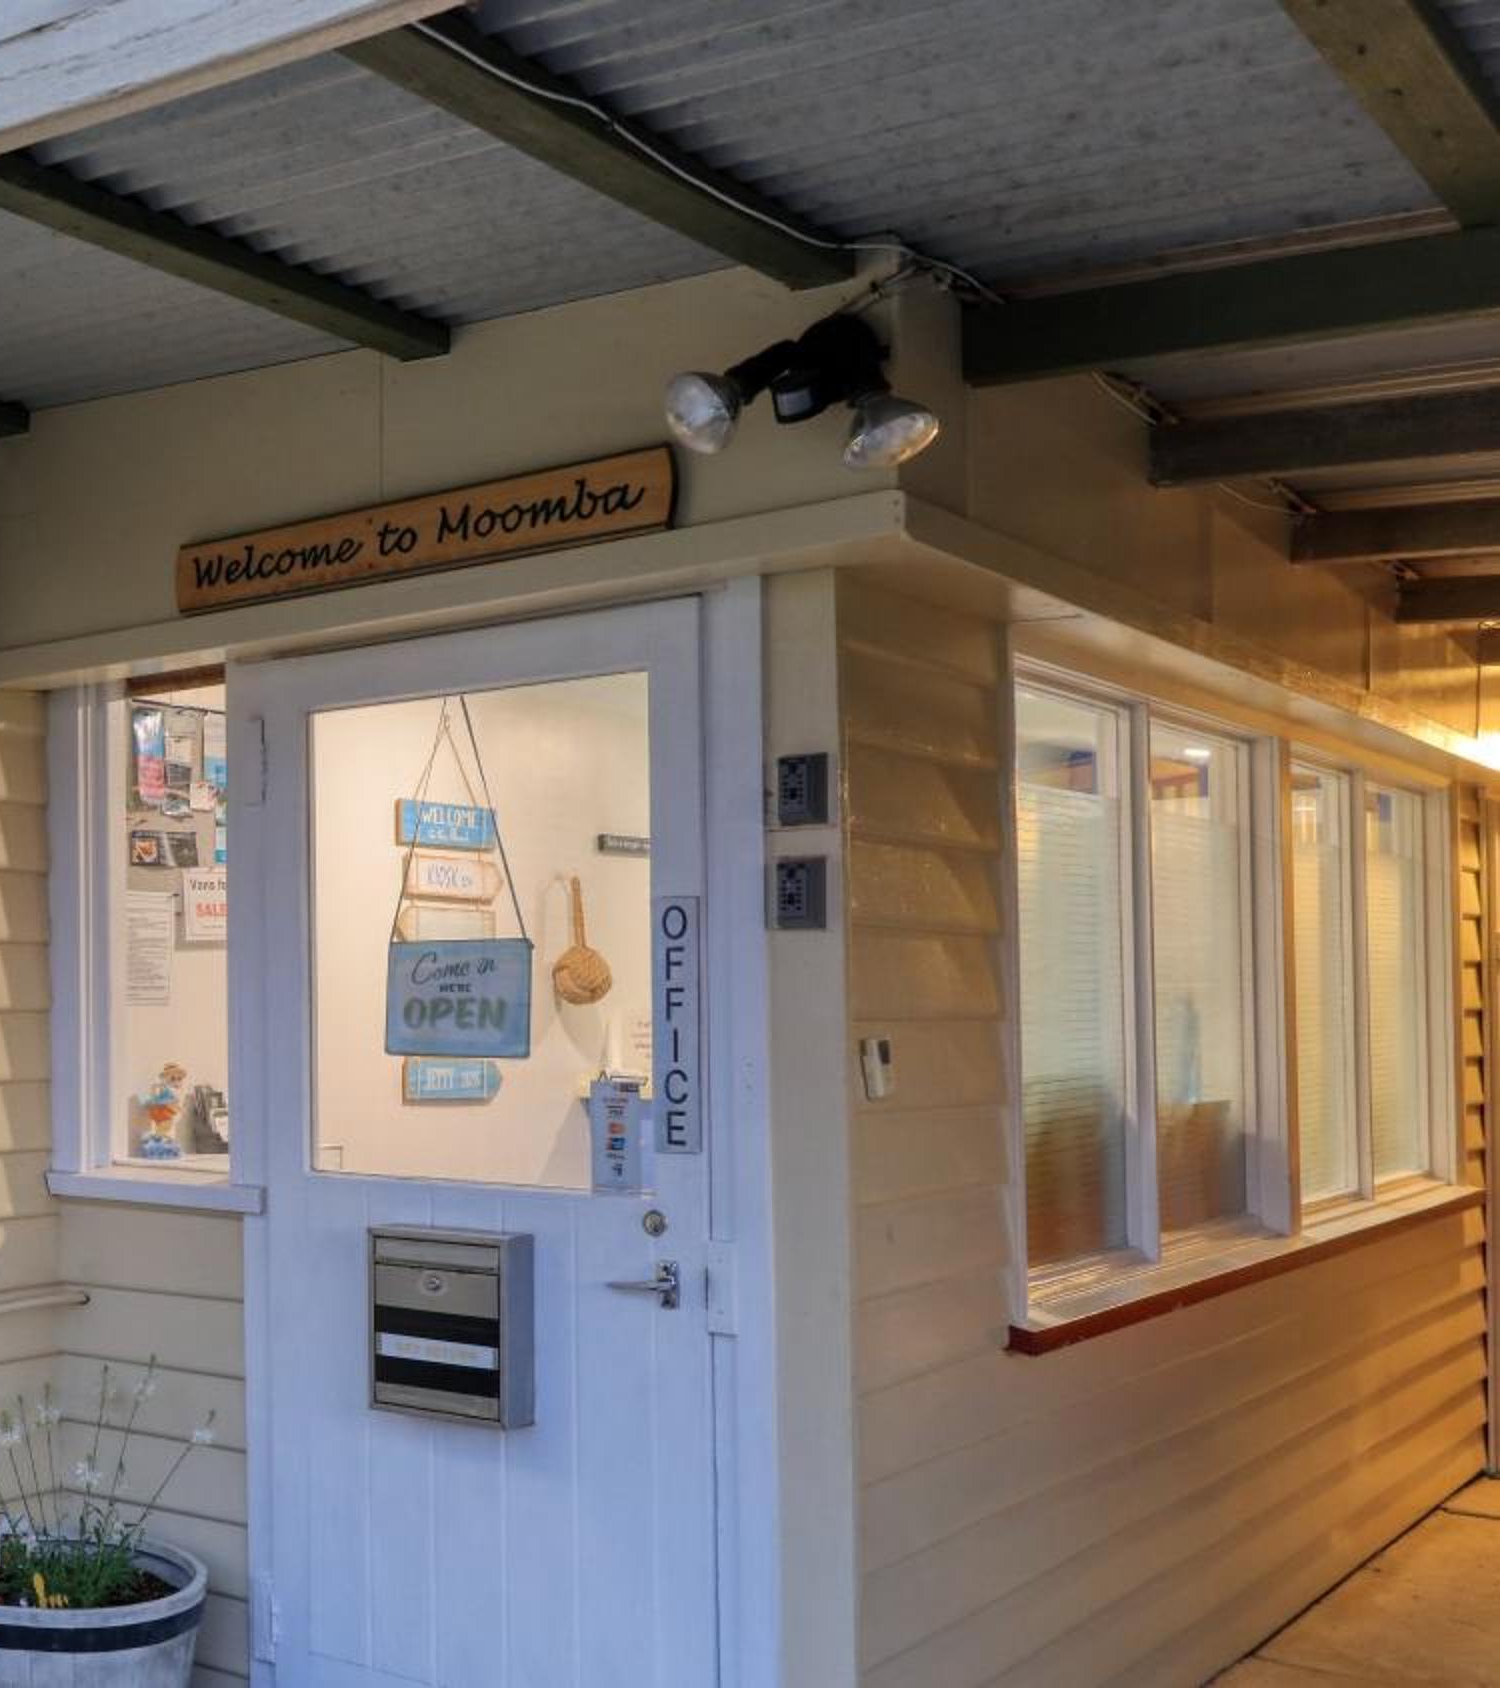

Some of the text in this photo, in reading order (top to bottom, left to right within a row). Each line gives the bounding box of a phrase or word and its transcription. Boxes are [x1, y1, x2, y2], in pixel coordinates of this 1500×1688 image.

[192, 478, 645, 590] Welcome to Moomba
[420, 806, 476, 829] WELCOME
[217, 878, 228, 892] fo
[195, 902, 228, 919] SALE
[411, 951, 496, 986] Come in
[403, 996, 508, 1032] OPEN
[661, 904, 688, 1147] OFFICE
